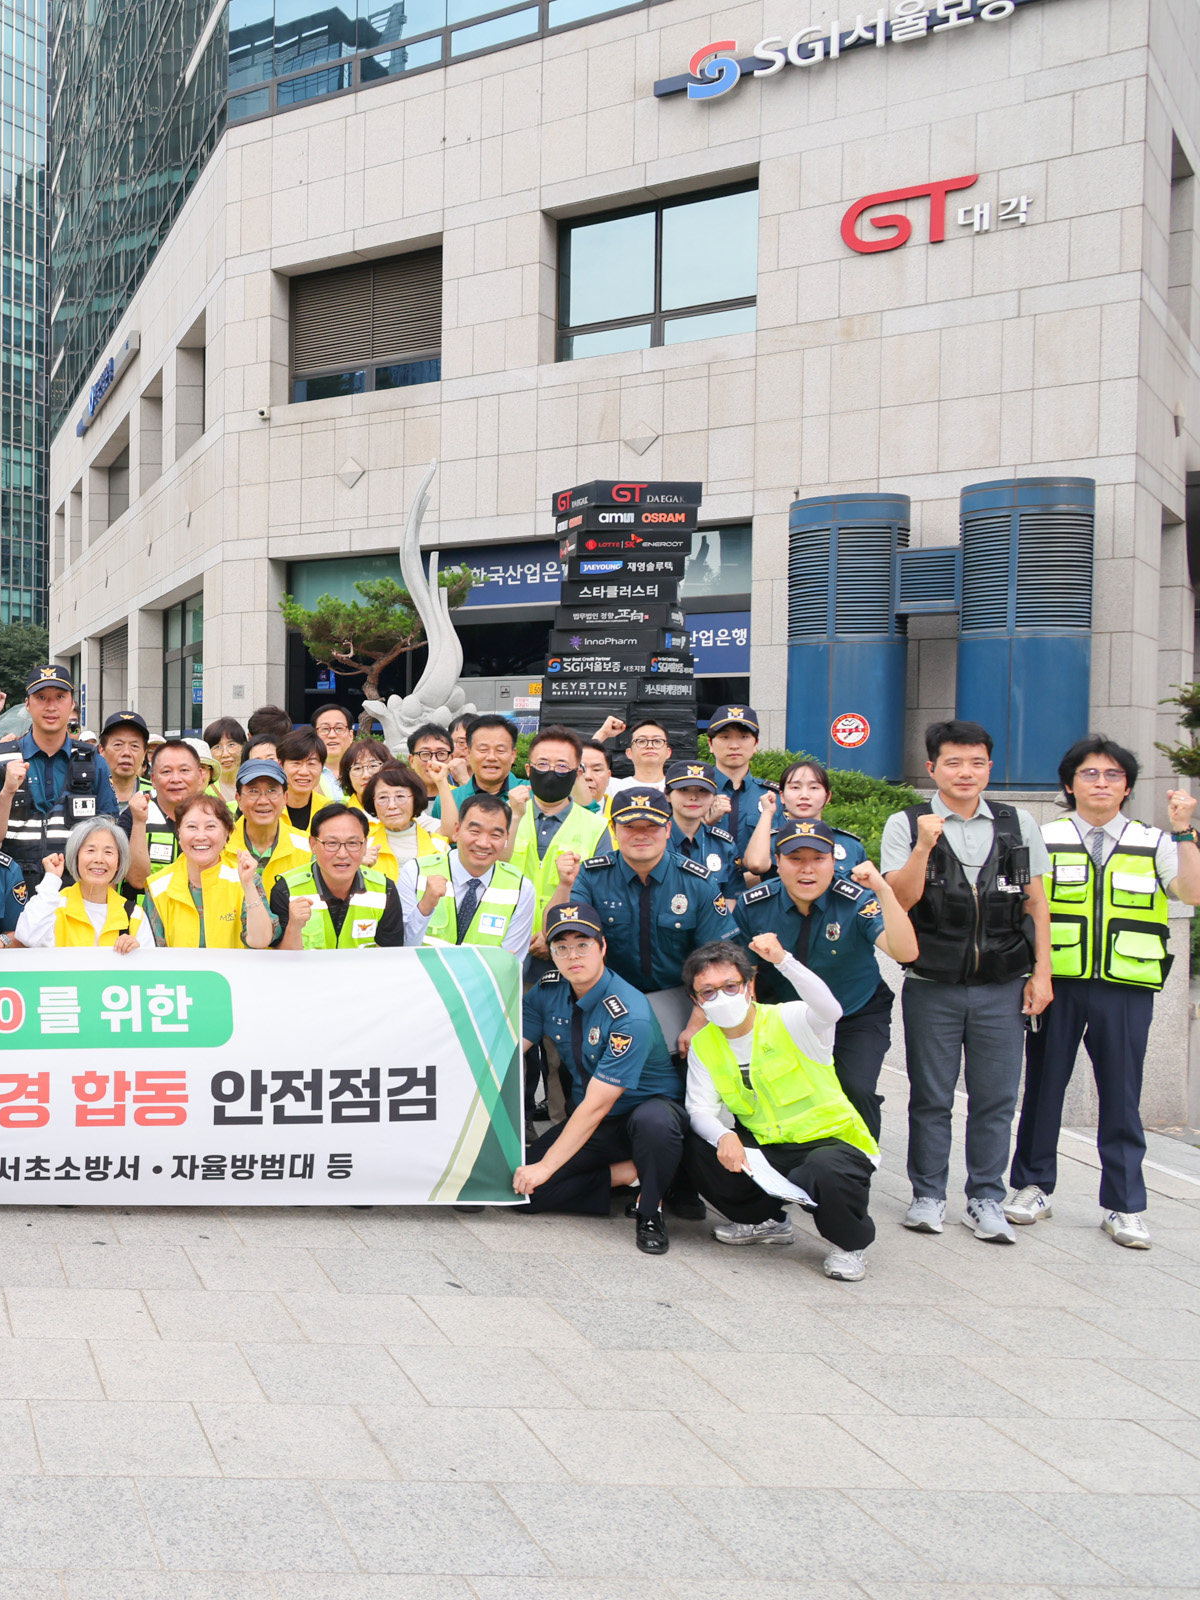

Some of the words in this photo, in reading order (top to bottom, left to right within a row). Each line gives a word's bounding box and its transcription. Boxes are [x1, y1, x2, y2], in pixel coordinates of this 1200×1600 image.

[840, 173, 980, 255] GT
[957, 194, 1034, 233] 대각
[557, 490, 573, 512] GT
[611, 483, 649, 503] GT
[646, 494, 686, 504] DAEGAK
[641, 512, 686, 523] OSRAM
[624, 541, 636, 549] SK
[471, 561, 561, 588] 한국산업은
[583, 563, 622, 572] JAEYOUNG
[627, 561, 674, 573] 재영솔루텍
[578, 584, 659, 599] 스타클러스터
[584, 637, 638, 646] InnoPharm
[562, 661, 621, 673] SGI서울보증
[552, 682, 628, 690] KEYSTONE
[37, 985, 81, 1034] 를
[100, 983, 193, 1033] 위한
[71, 1070, 189, 1128] 합동
[210, 1065, 437, 1126] 안전점검
[170, 1152, 315, 1181] 자율방범대
[325, 1152, 355, 1180] 등
